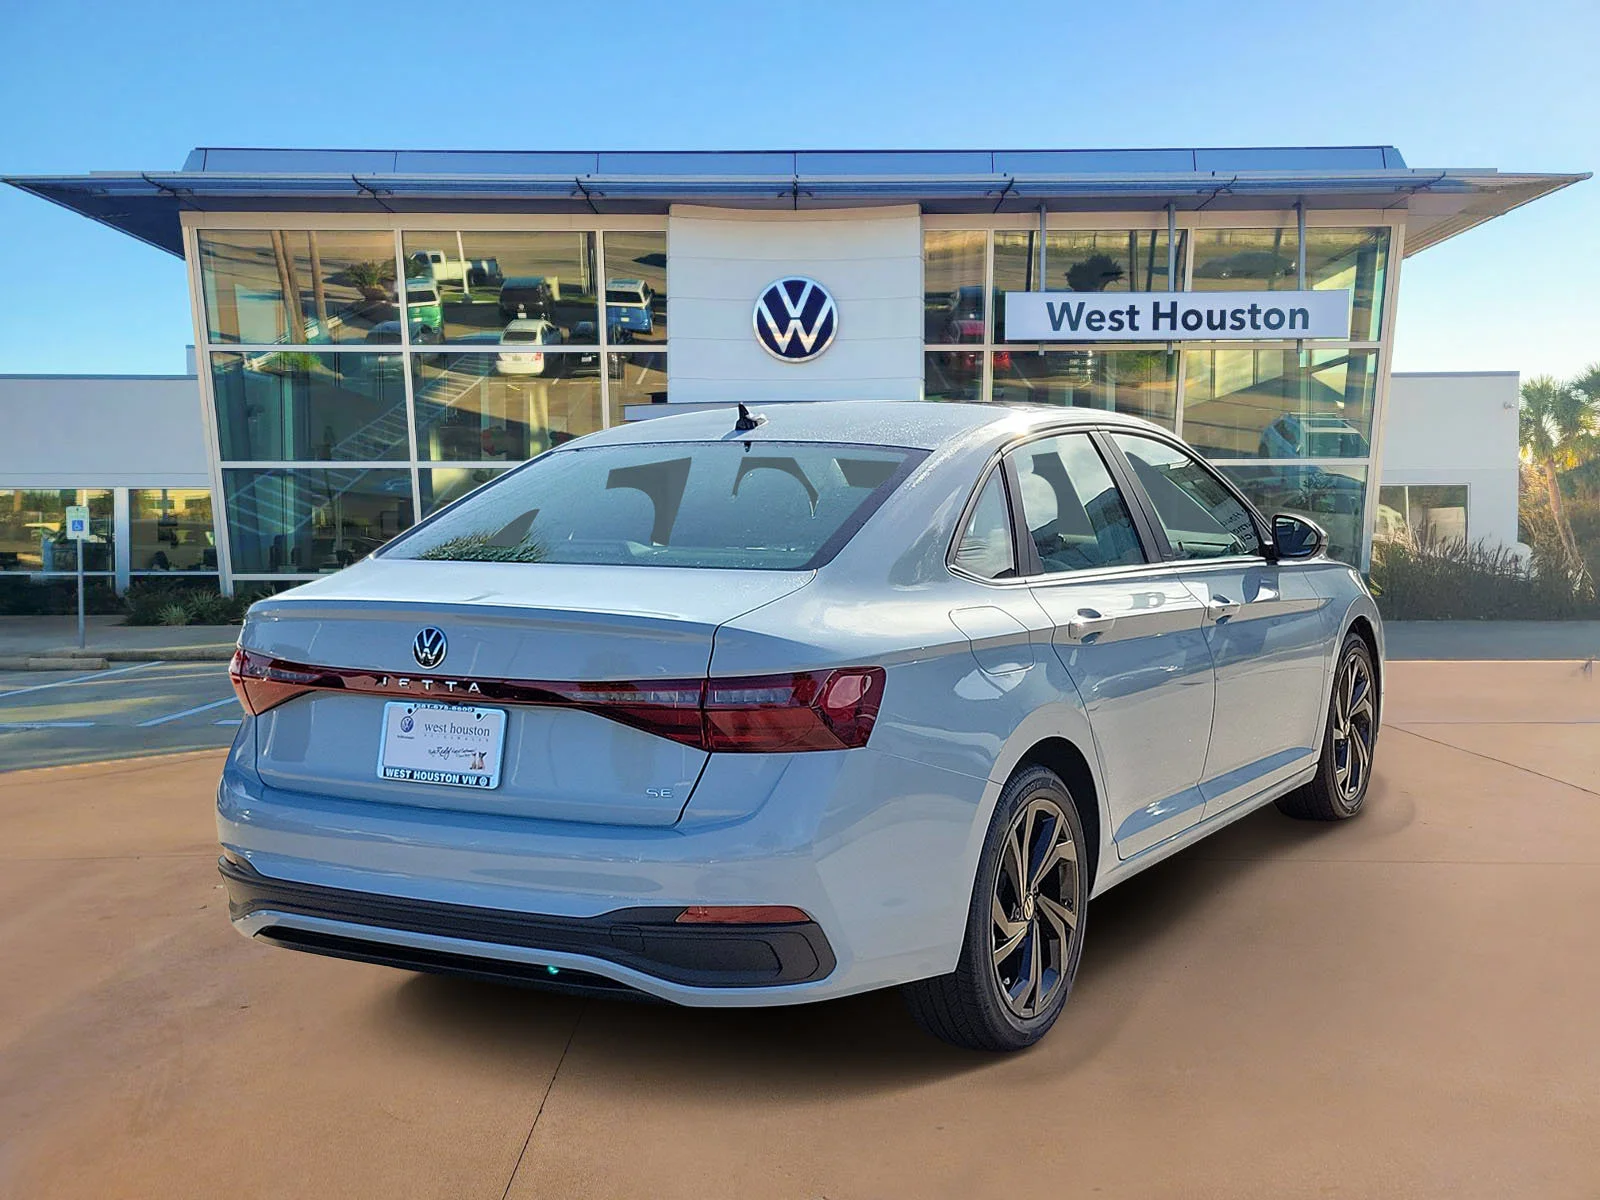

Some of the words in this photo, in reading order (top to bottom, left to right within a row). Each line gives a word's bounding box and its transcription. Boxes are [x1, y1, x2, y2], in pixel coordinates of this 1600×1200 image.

[1046, 301, 1140, 332] West
[1152, 301, 1310, 332] Houston
[380, 676, 481, 694] JETTA
[424, 722, 447, 733] west
[450, 722, 490, 737] houston
[385, 767, 413, 779] WEST
[413, 771, 460, 784] HOUSTON
[462, 775, 477, 785] VW
[646, 788, 673, 798] SE
